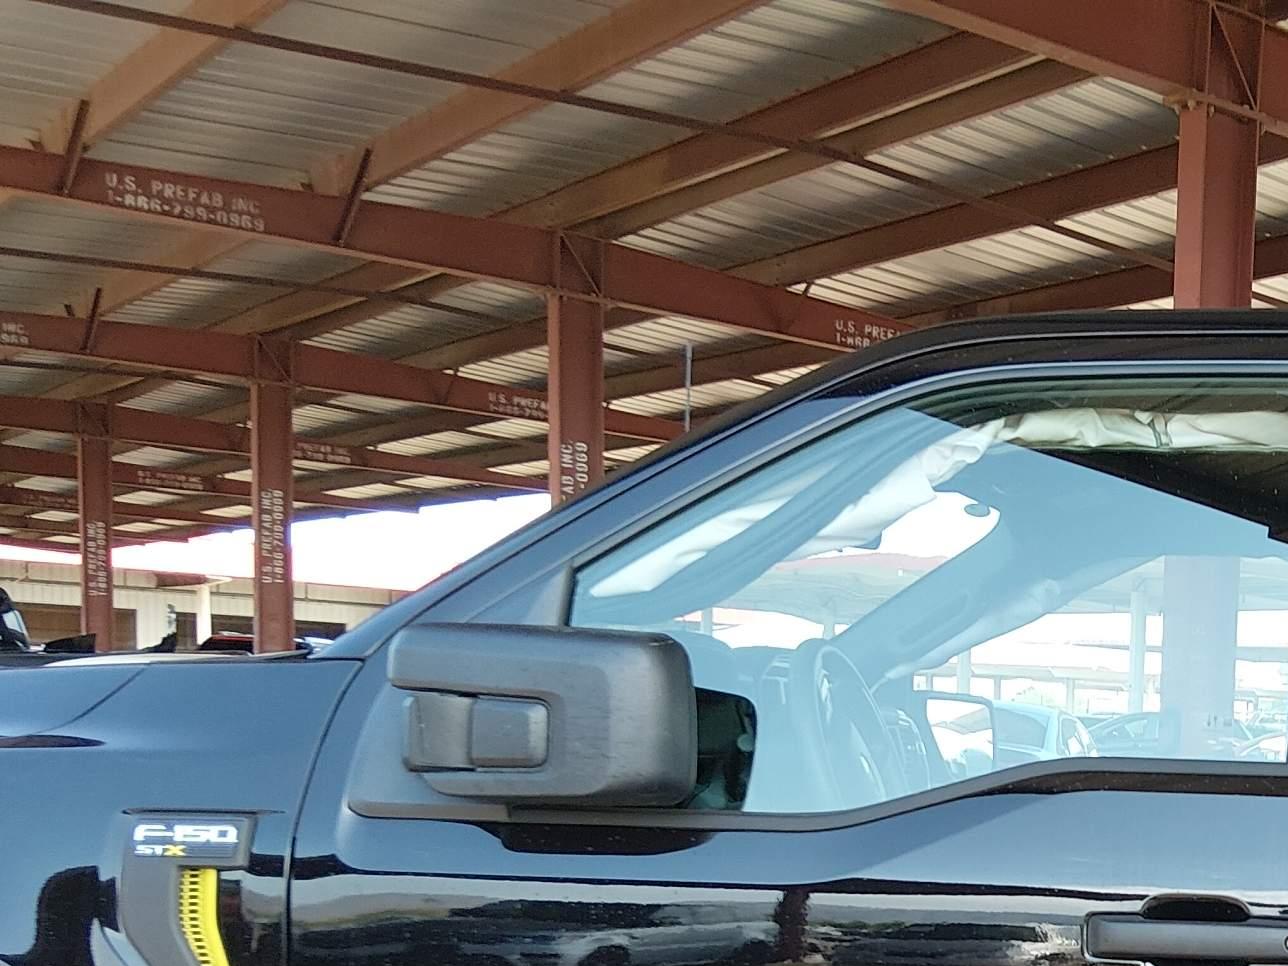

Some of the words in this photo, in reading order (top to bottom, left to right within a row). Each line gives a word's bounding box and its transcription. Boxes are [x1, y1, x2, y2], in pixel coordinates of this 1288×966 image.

[105, 172, 143, 193] U.S.
[151, 179, 224, 208] PREFAB
[835, 320, 858, 334] U.S.
[133, 824, 239, 843] F-150
[134, 844, 187, 857] STX
